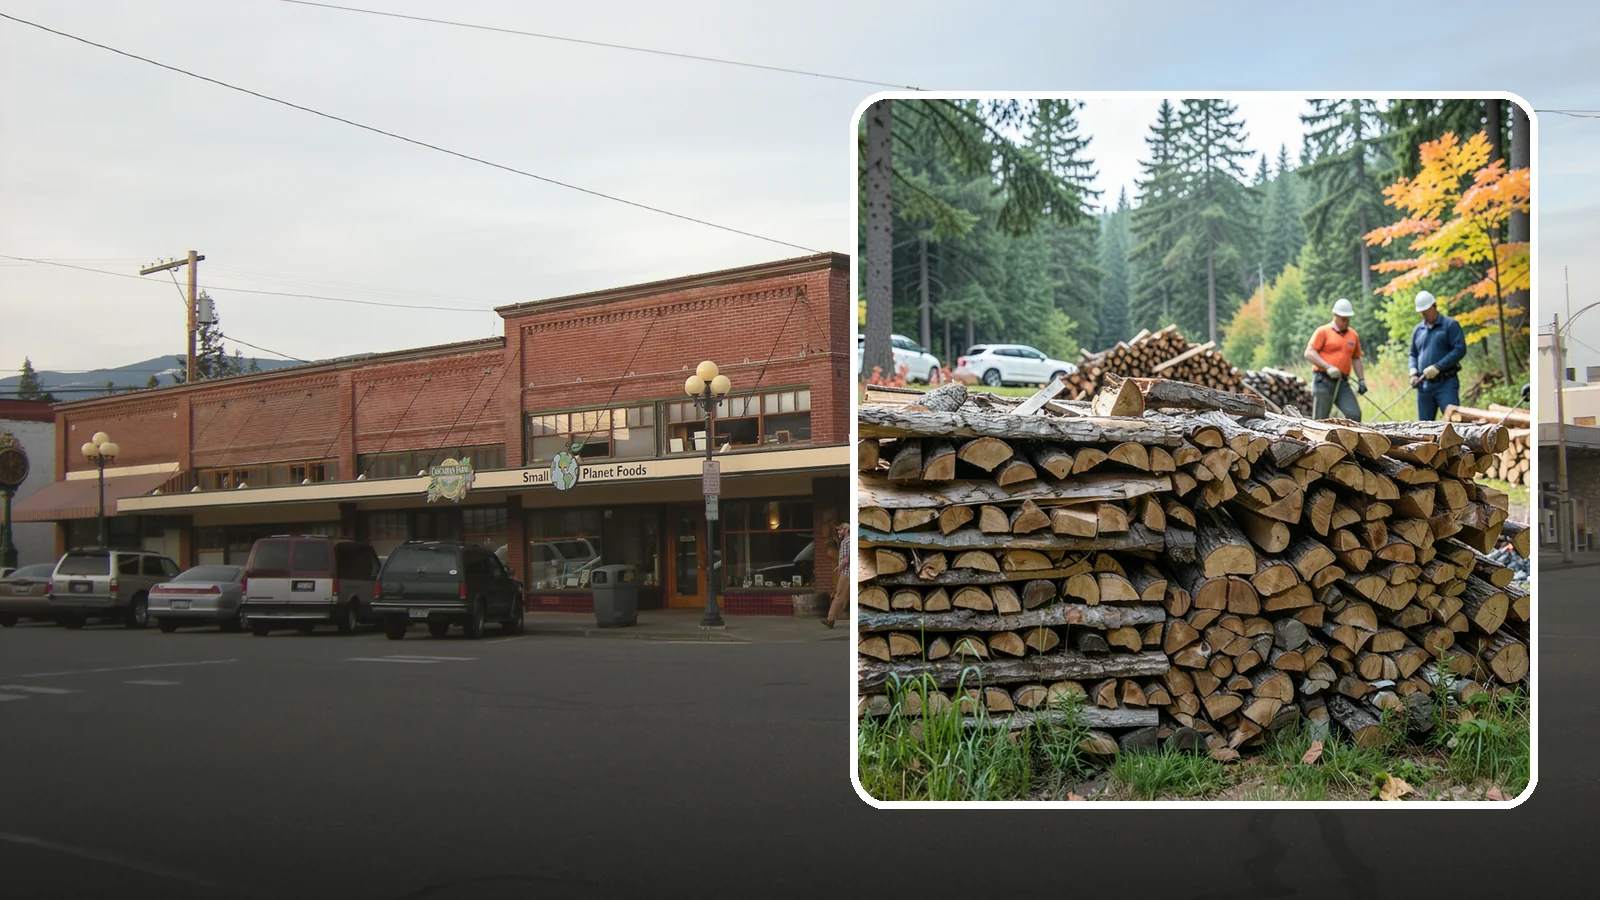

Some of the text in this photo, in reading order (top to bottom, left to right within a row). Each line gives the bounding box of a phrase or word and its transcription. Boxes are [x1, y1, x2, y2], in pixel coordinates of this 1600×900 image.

[523, 464, 647, 483] Small Planet Foods
